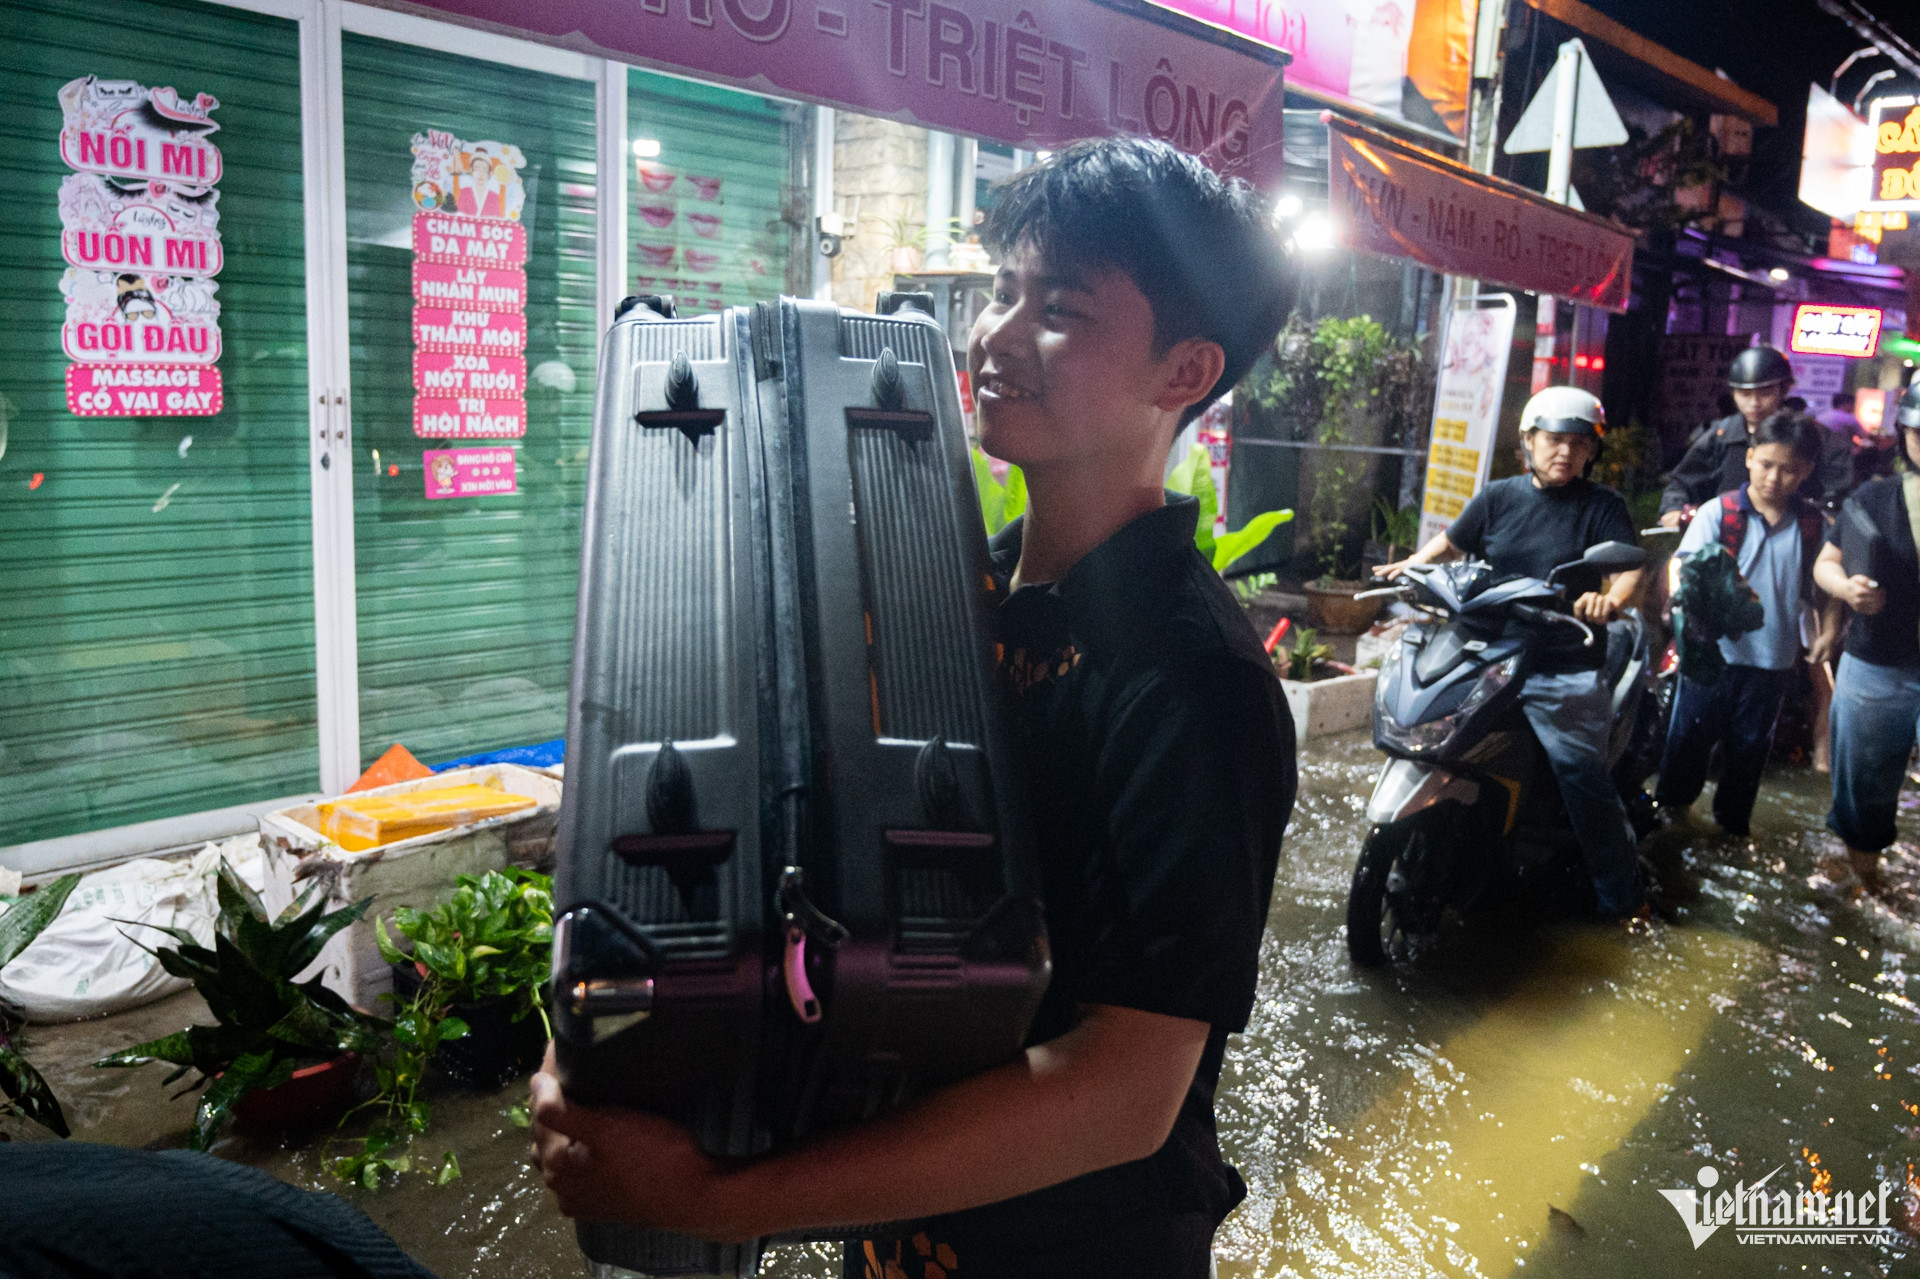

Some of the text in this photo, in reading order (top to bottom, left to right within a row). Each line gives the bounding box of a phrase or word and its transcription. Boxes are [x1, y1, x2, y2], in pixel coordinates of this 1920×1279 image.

[872, 0, 1090, 126] TRIỆT
[1107, 58, 1250, 167] LÔNG
[79, 125, 206, 178] NỐI MI
[481, 224, 514, 242] SÓC
[78, 222, 208, 270] UỐN MI
[431, 235, 460, 254] DA
[478, 286, 519, 306] MỤN
[77, 317, 133, 357] GỘI
[481, 327, 520, 347] MÔI
[453, 352, 490, 370] XÓA
[91, 368, 201, 387] MASSAGE
[424, 366, 465, 388] NỐT
[78, 386, 213, 410] CỔ VAI GÁY
[458, 397, 486, 415] TRỊ
[423, 411, 519, 433] HÔI NÁCH
